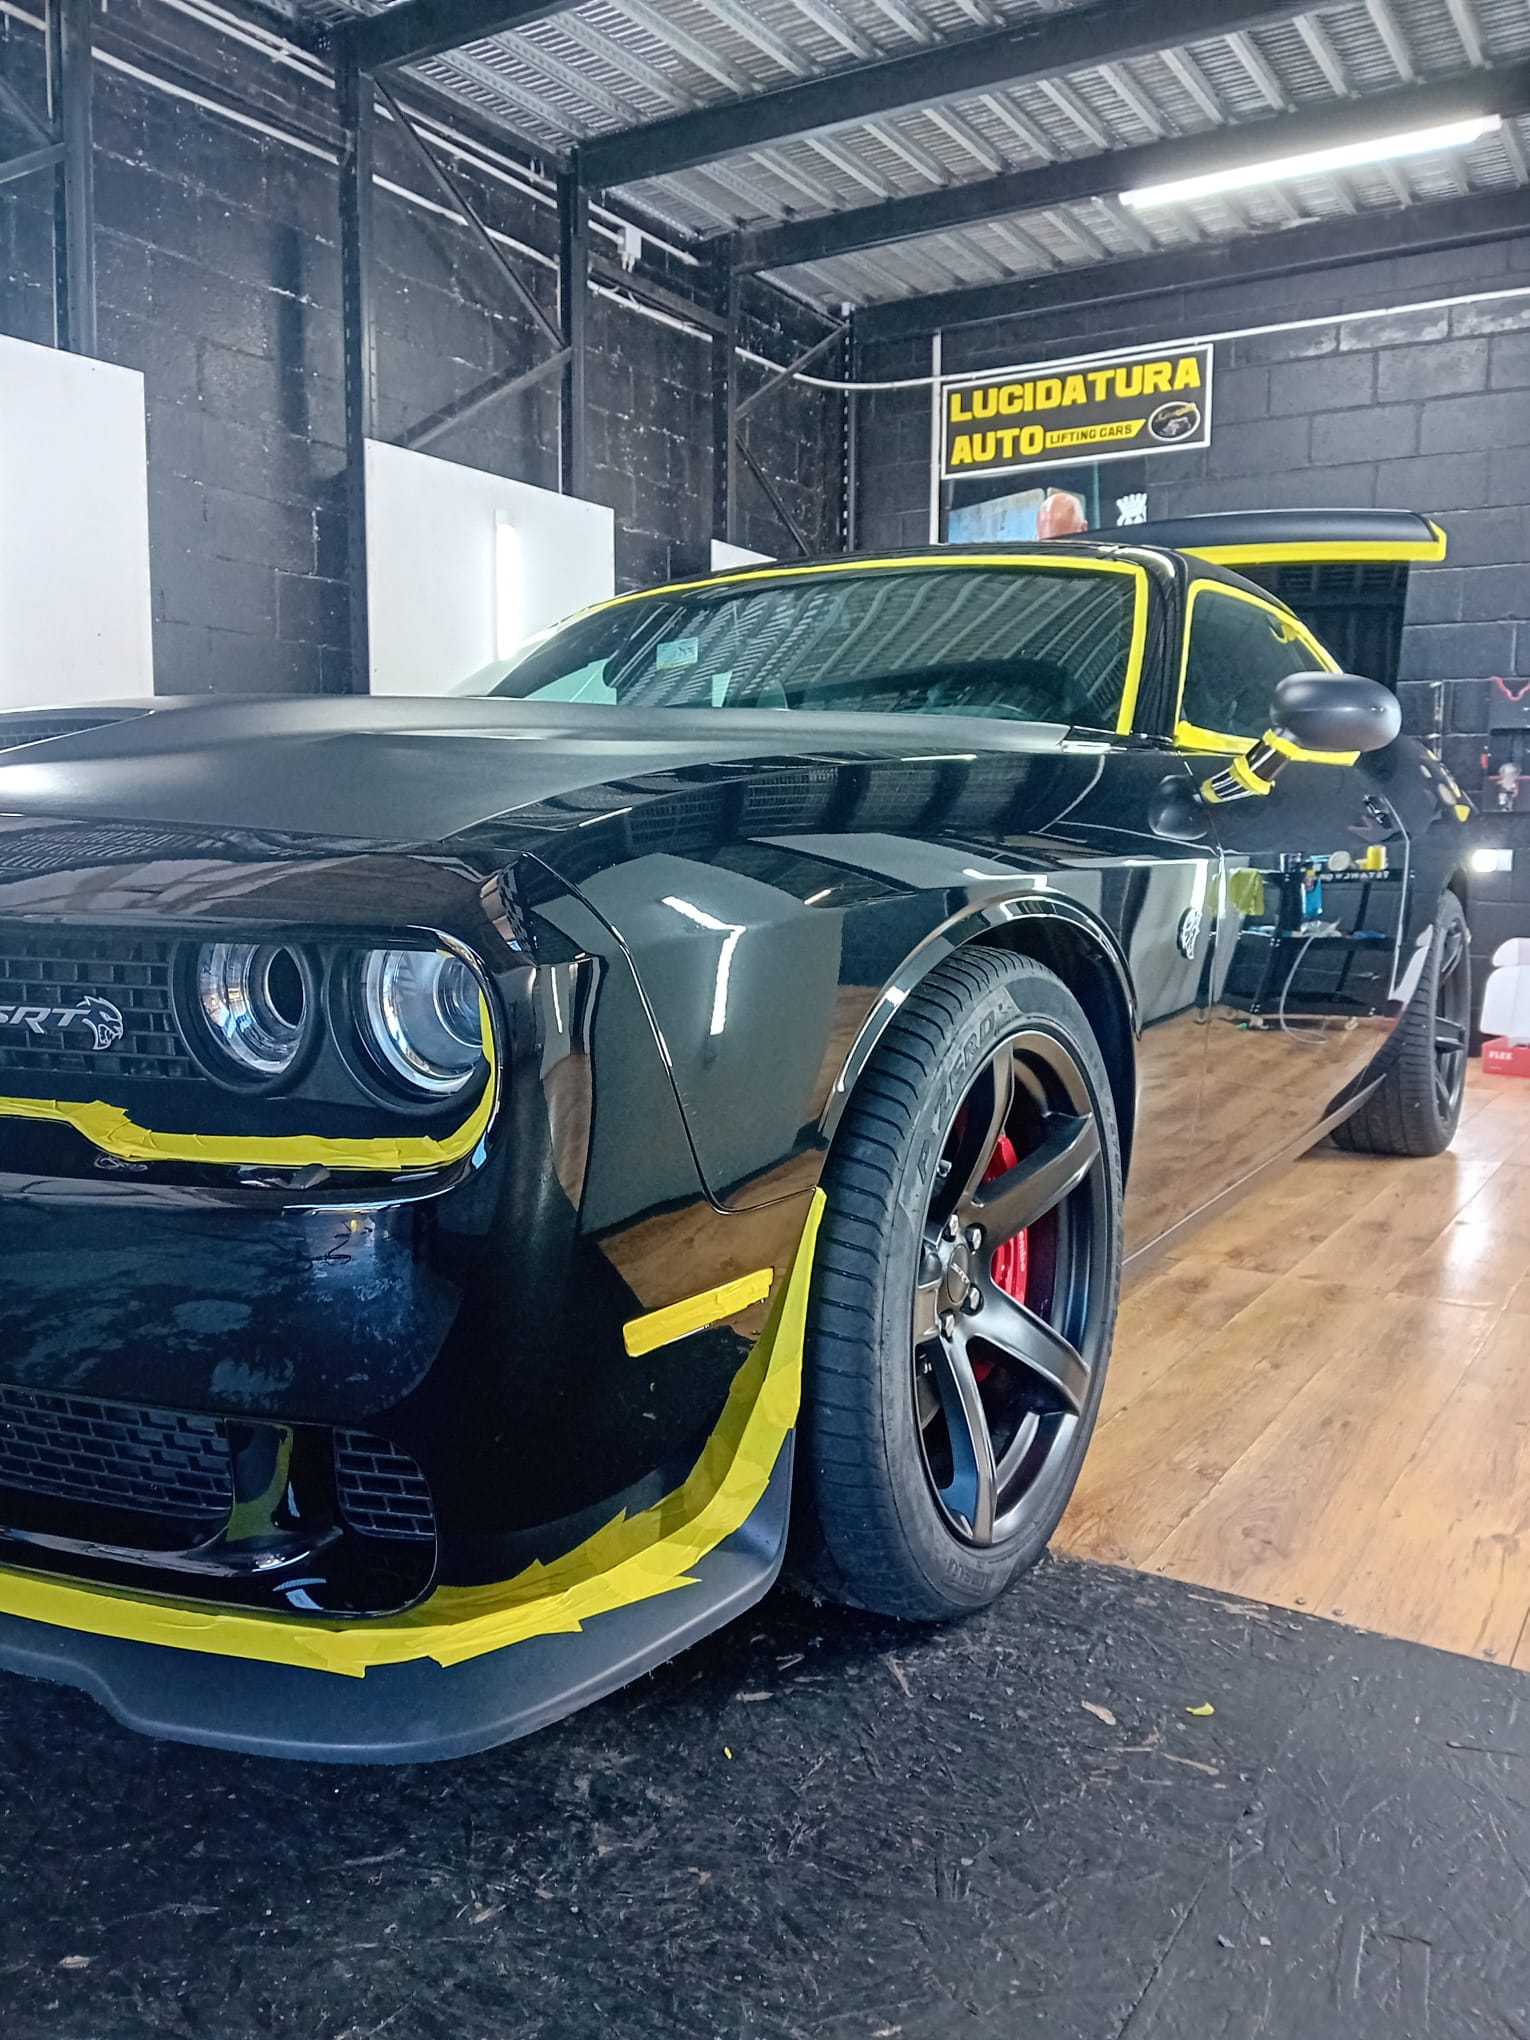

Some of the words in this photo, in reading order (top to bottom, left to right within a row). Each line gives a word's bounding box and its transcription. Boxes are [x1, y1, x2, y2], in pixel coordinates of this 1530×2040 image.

[949, 356, 1201, 423] LUCIDATURA
[950, 424, 1045, 466] AUTO
[1050, 429, 1097, 444] LIFTING
[1099, 424, 1132, 437] CARS
